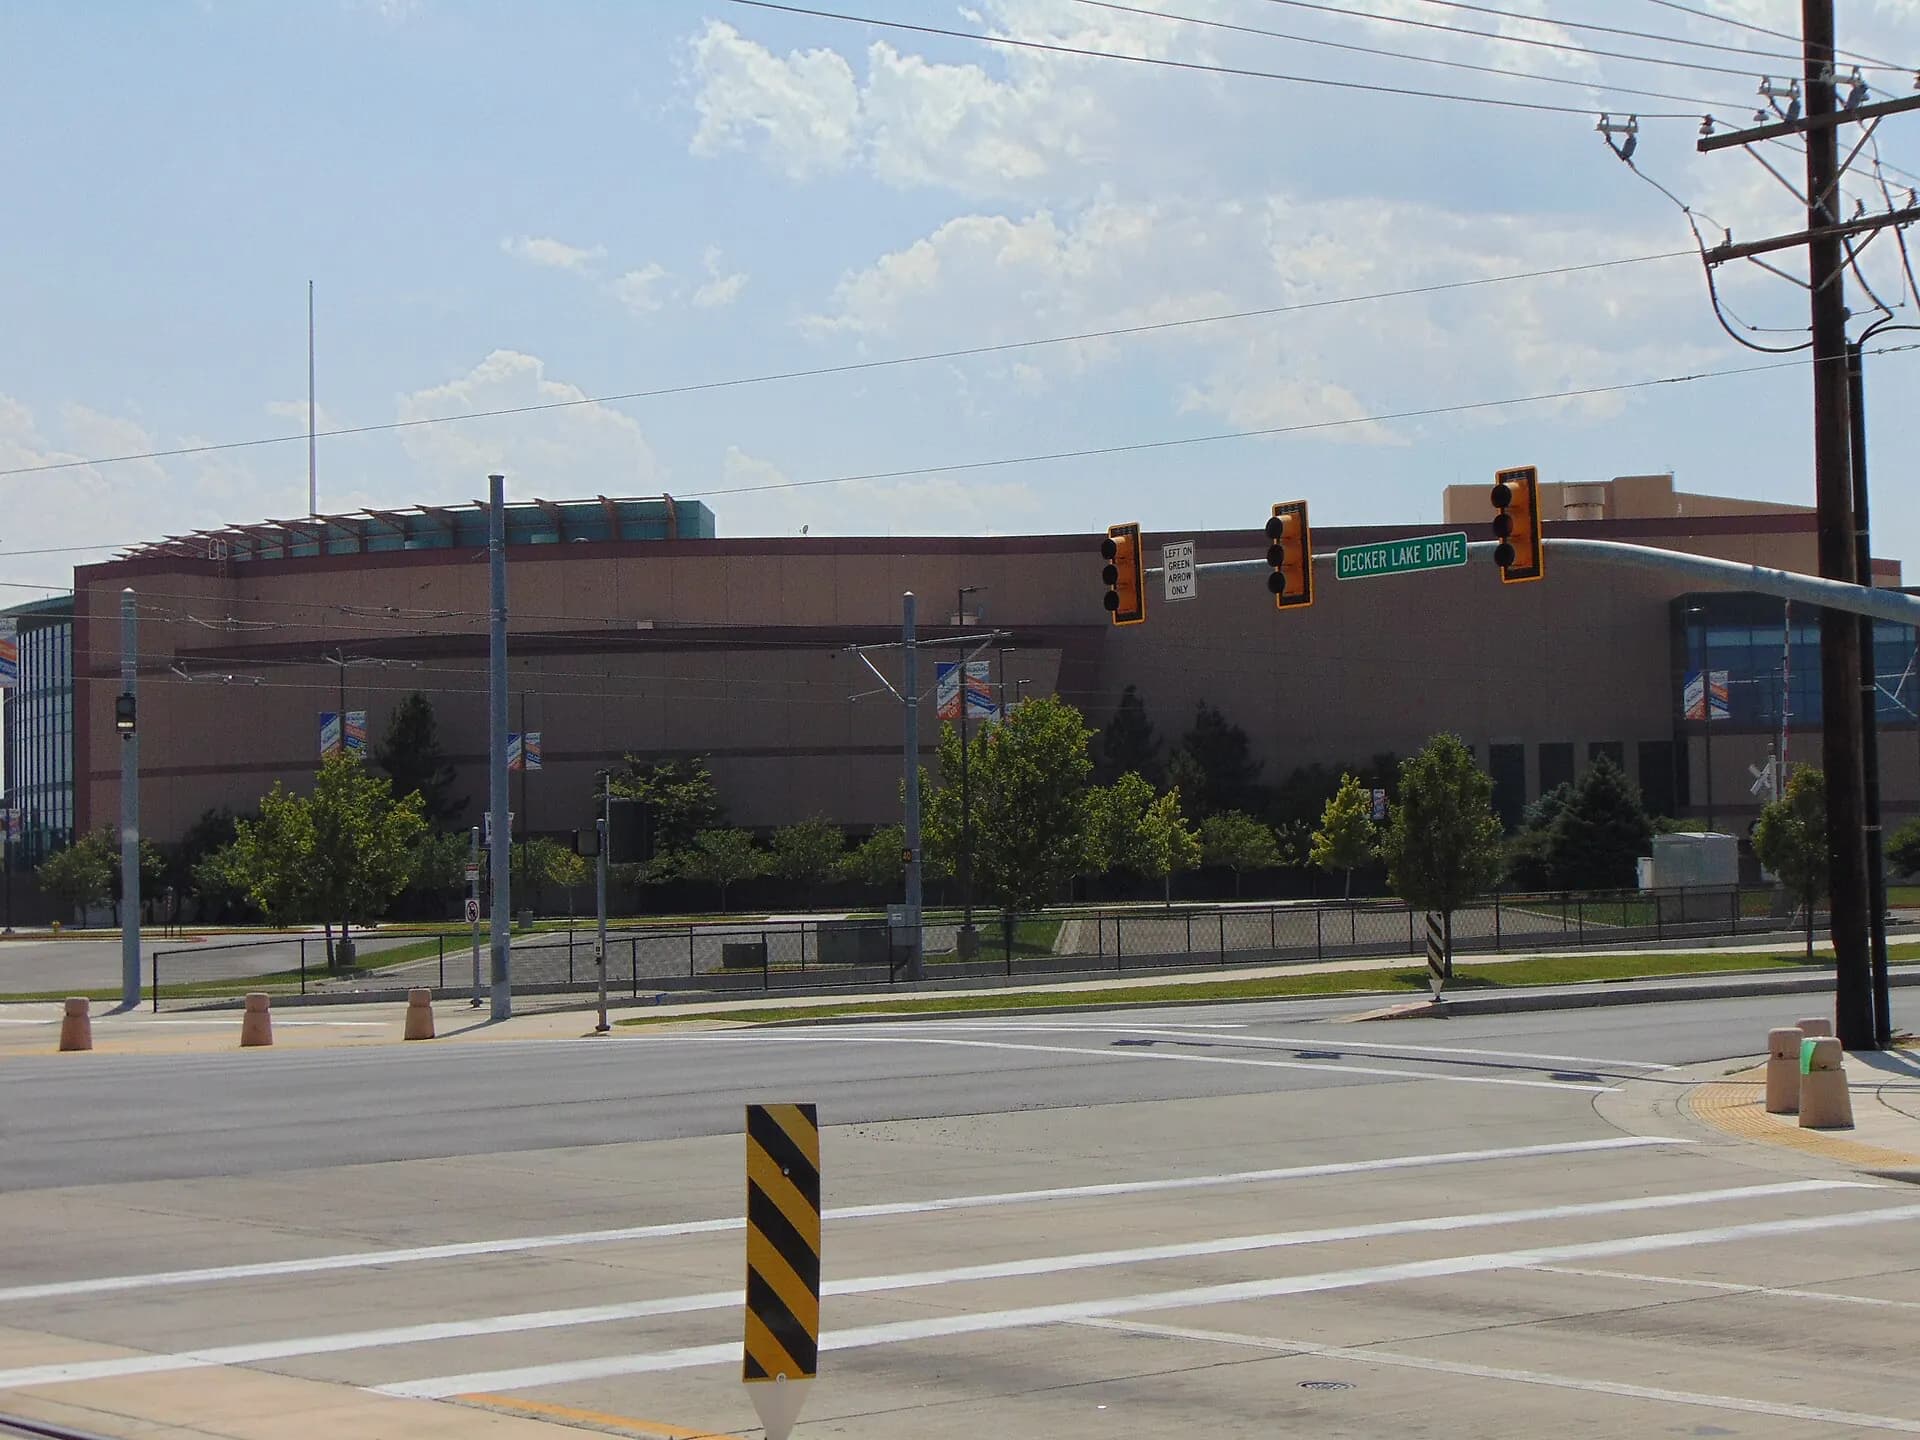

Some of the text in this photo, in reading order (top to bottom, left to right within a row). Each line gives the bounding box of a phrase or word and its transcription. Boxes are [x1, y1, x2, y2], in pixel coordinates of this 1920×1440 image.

[1165, 546, 1192, 559] LEFT ON
[1342, 541, 1460, 573] DECKER LAKE DRIVE
[1168, 560, 1190, 571] GREEN
[1168, 572, 1191, 583] ARROW
[1171, 585, 1188, 595] ONLY
